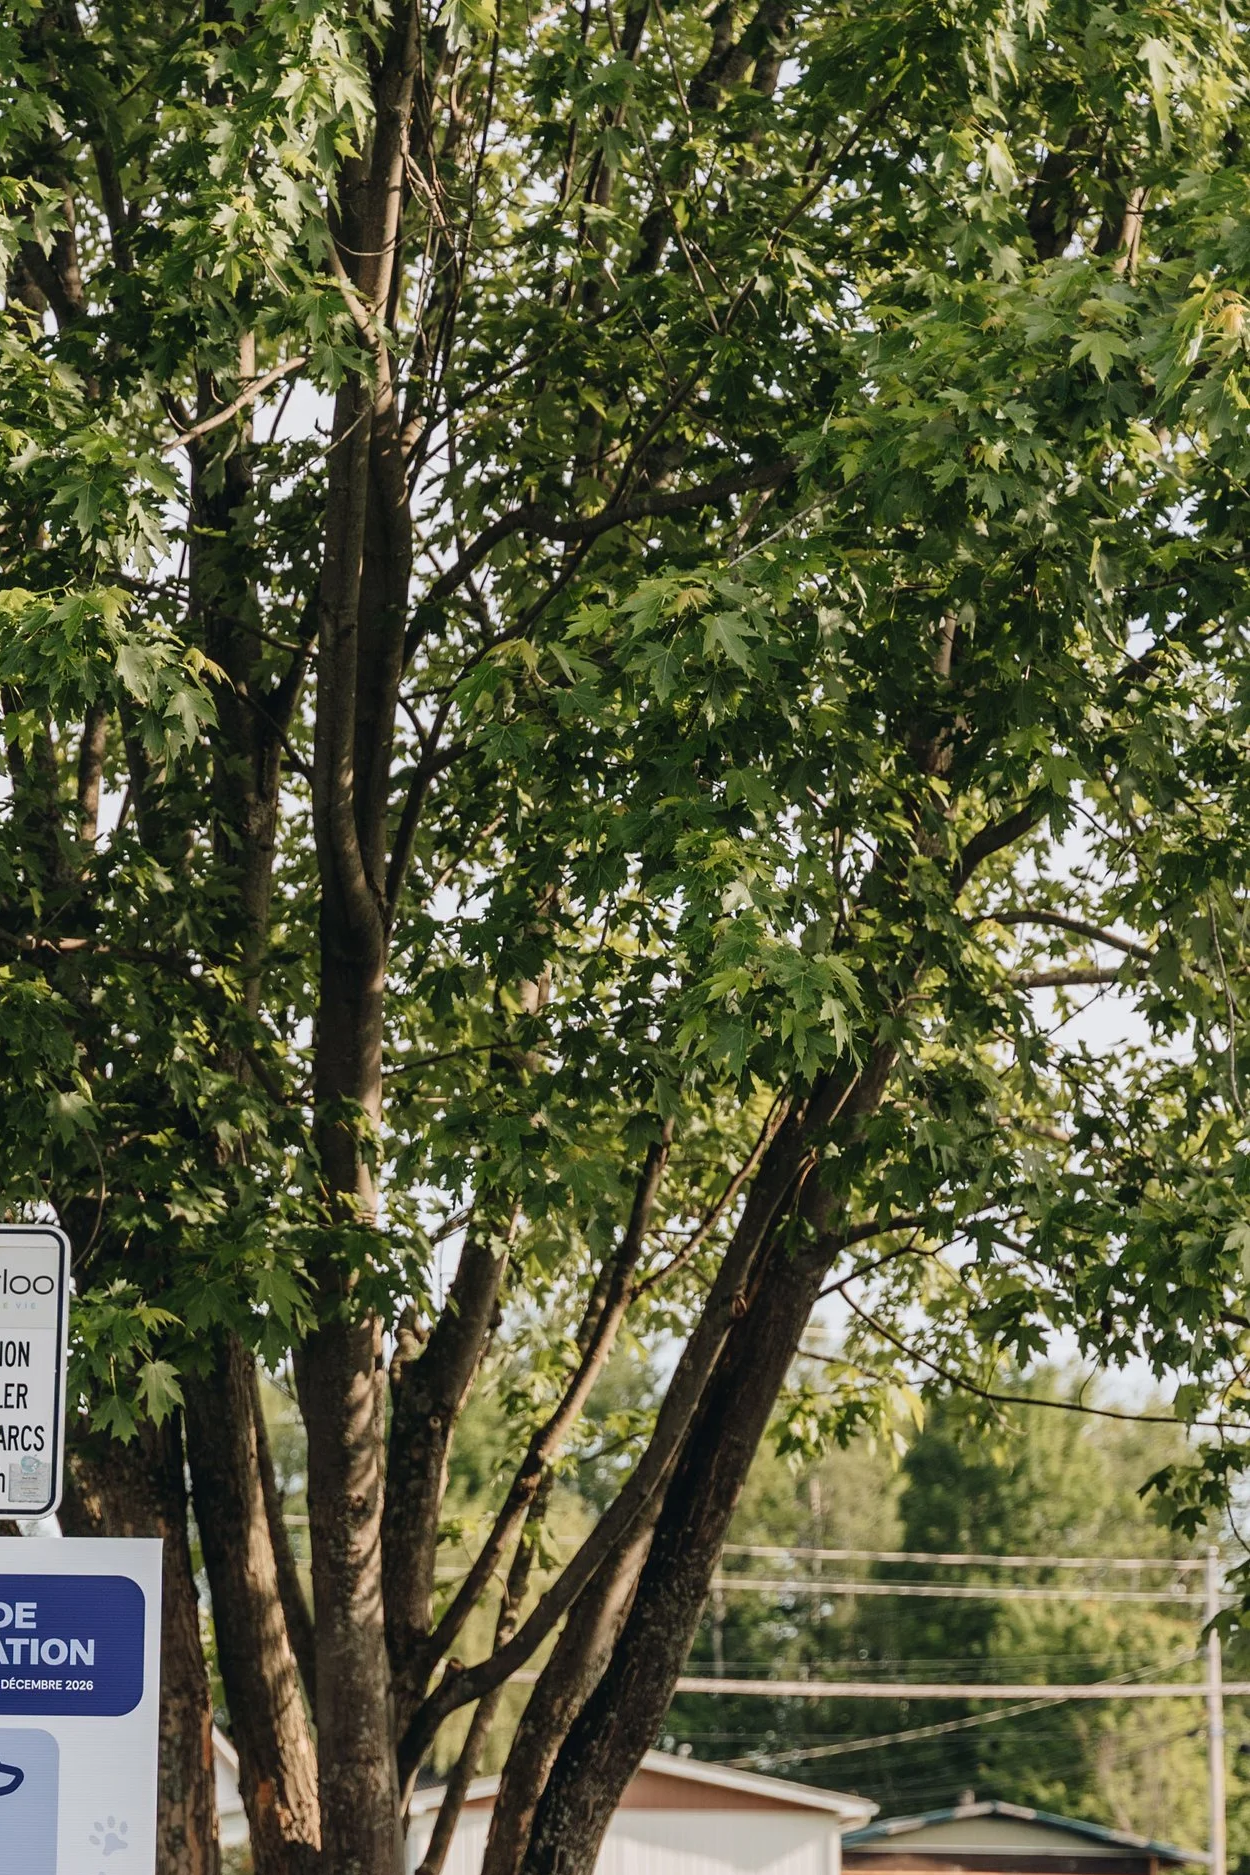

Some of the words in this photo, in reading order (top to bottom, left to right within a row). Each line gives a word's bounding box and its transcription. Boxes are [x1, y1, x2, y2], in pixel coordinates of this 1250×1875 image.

[16, 1302, 37, 1310] VIE
[0, 1677, 63, 1690] DÉCEMBRE
[65, 1680, 94, 1691] 2026
